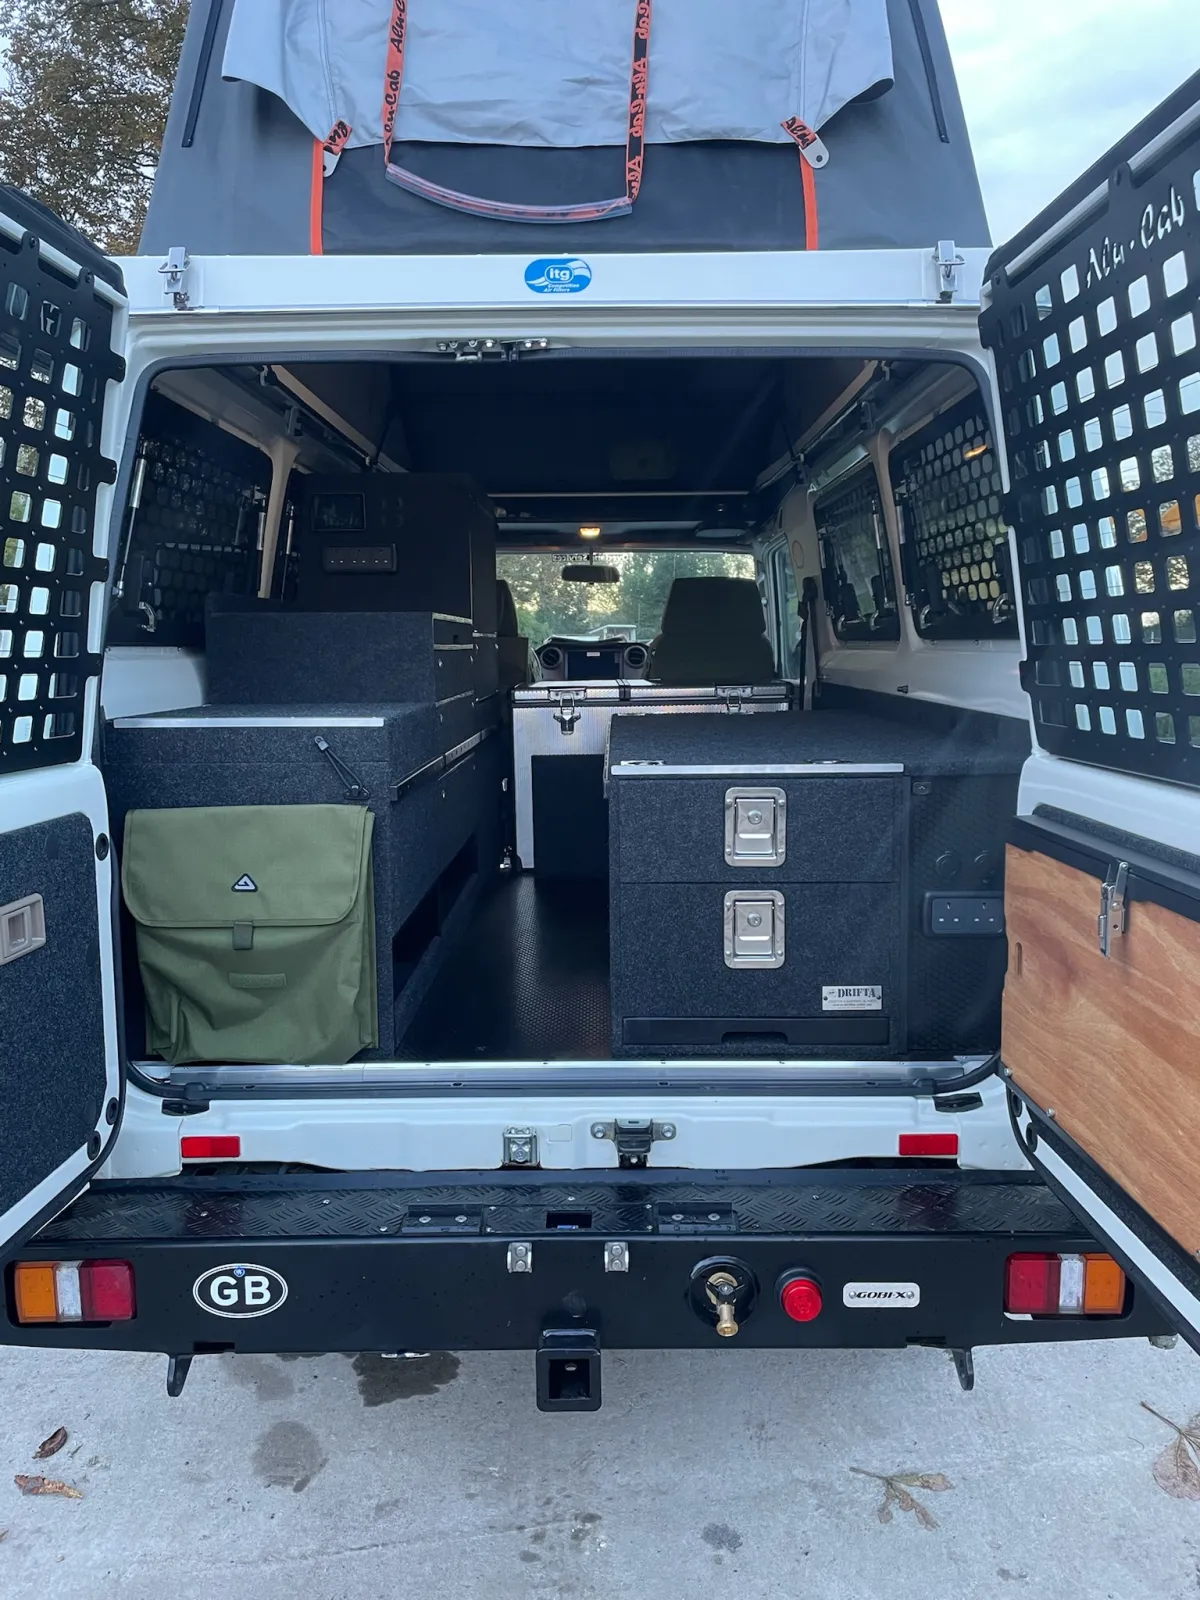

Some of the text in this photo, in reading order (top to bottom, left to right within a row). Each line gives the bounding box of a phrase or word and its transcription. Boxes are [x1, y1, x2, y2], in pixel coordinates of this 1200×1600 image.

[549, 267, 571, 281] itg
[837, 988, 876, 998] DRIFTA
[209, 1275, 271, 1307] GB
